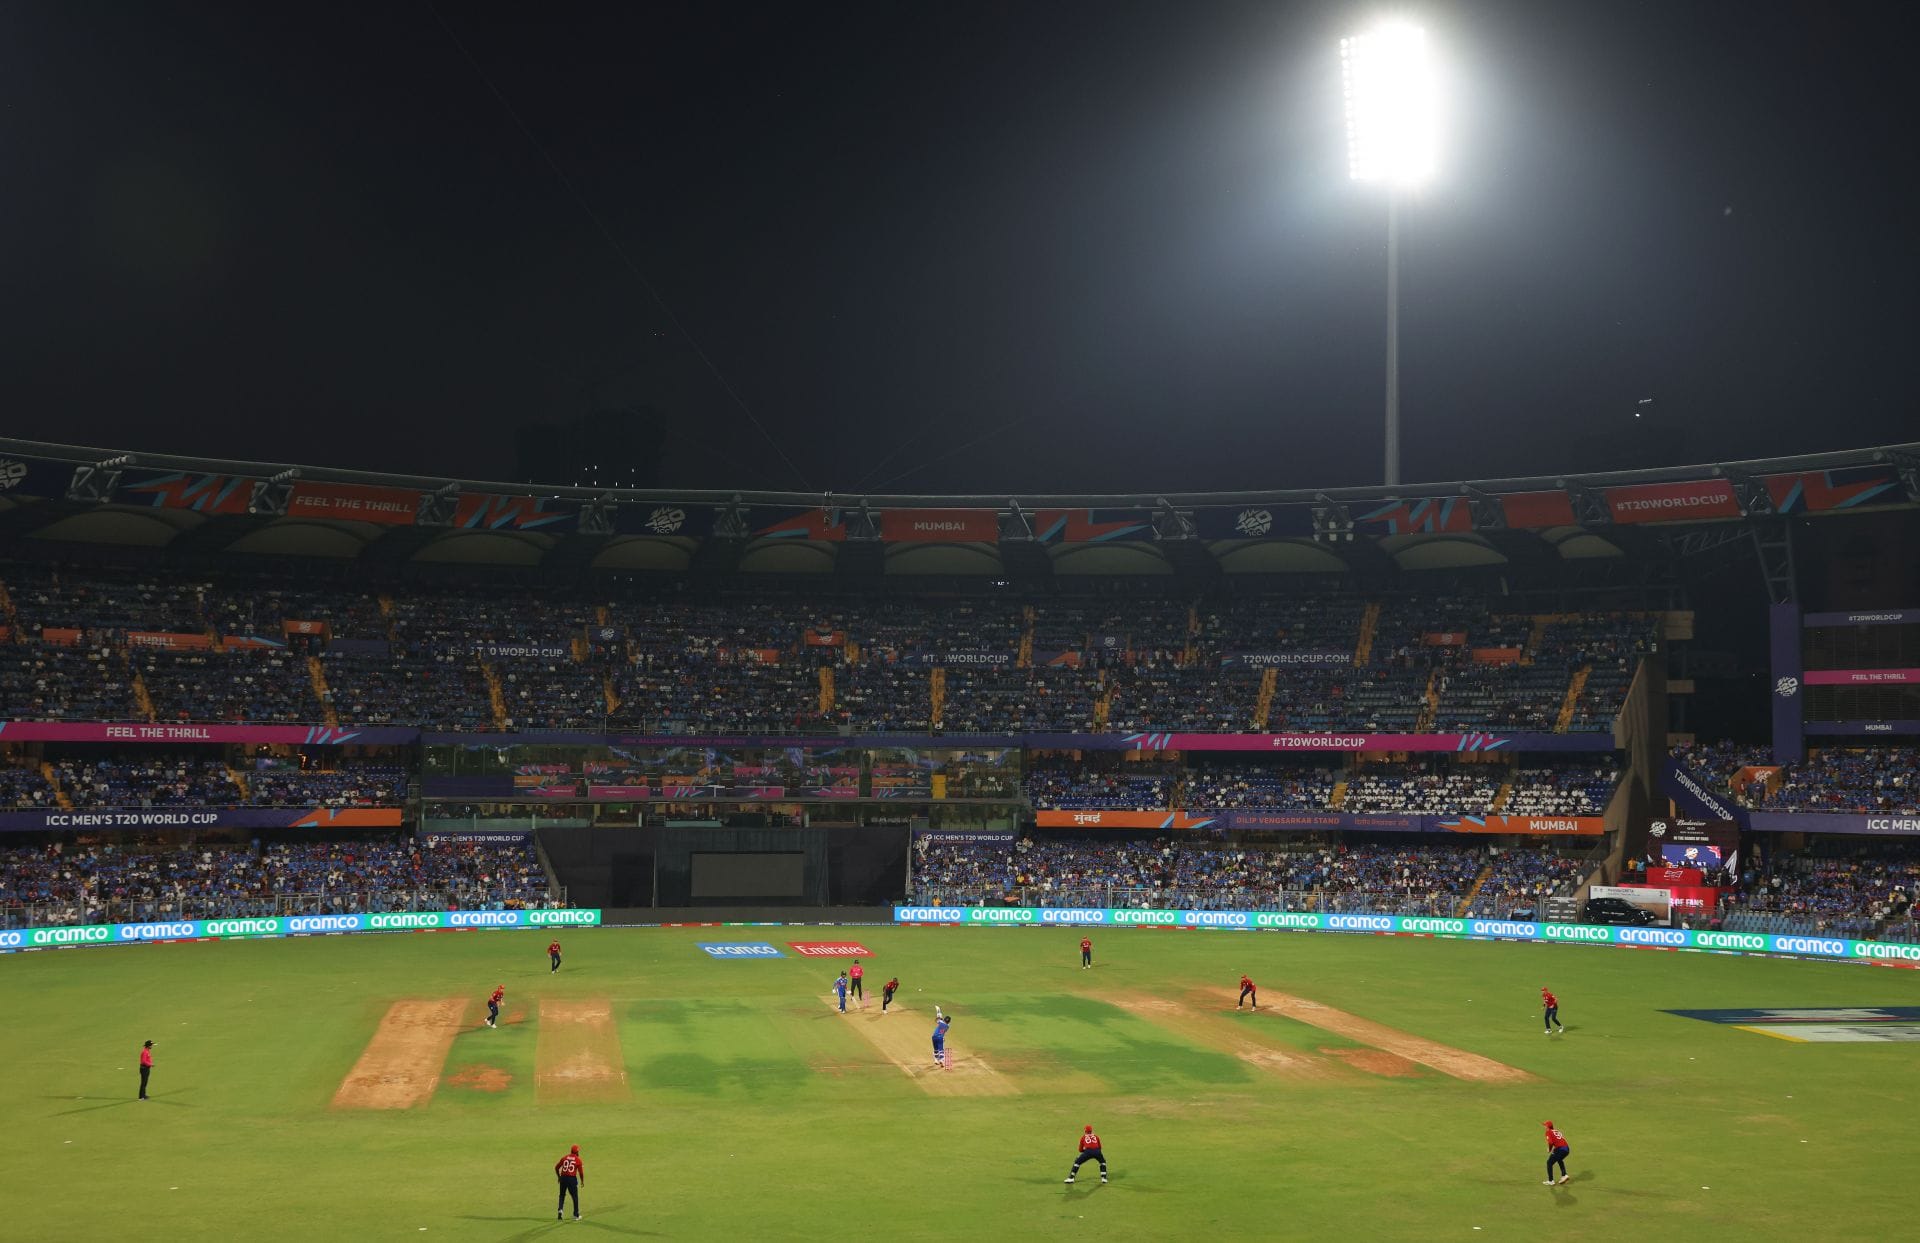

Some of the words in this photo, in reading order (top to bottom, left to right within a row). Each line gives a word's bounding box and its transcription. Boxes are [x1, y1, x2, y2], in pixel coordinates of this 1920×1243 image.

[295, 495, 330, 507] FEEL
[335, 497, 361, 510] THE
[364, 500, 412, 513] THRILL
[1615, 494, 1729, 511] #T20WORLDCUP
[914, 522, 965, 530] MUMBAI
[135, 636, 177, 647] THRILL
[499, 647, 539, 657] WORLD
[541, 648, 564, 658] CUP
[106, 727, 137, 738] FEEL
[140, 727, 164, 738] THE
[167, 728, 210, 739] THRILL
[1272, 737, 1366, 747] #T20WORLDCUP
[46, 815, 69, 826] ICC
[72, 814, 113, 826] MEN'S
[115, 814, 139, 825] T20
[141, 814, 189, 825] WORLD
[192, 813, 218, 824] CUP
[1313, 817, 1340, 825] STAND
[1529, 820, 1578, 831] MUMBAI
[1867, 819, 1889, 830] ICC
[371, 914, 439, 927] aramco
[451, 912, 518, 925] aramco
[529, 911, 595, 923] aramco
[901, 909, 961, 921] aramco
[971, 909, 1032, 921] aramco
[1043, 911, 1103, 922] aramco
[1115, 912, 1175, 923] aramco
[1186, 913, 1246, 925] aramco
[1258, 914, 1318, 926] aramco
[207, 919, 277, 934] aramco
[290, 917, 358, 930] aramco
[1329, 916, 1391, 929] aramco
[1402, 919, 1463, 932] aramco
[1474, 922, 1535, 935] aramco
[35, 928, 107, 942] aramco
[122, 924, 194, 939] aramco
[1546, 926, 1608, 940] aramco
[1620, 930, 1685, 945] aramco
[1697, 933, 1764, 949] aramco
[1776, 938, 1843, 954] aramco
[704, 945, 778, 955] aramco
[794, 944, 868, 956] Emirates
[1856, 943, 1920, 961] aramco
[562, 1160, 576, 1173] 95
